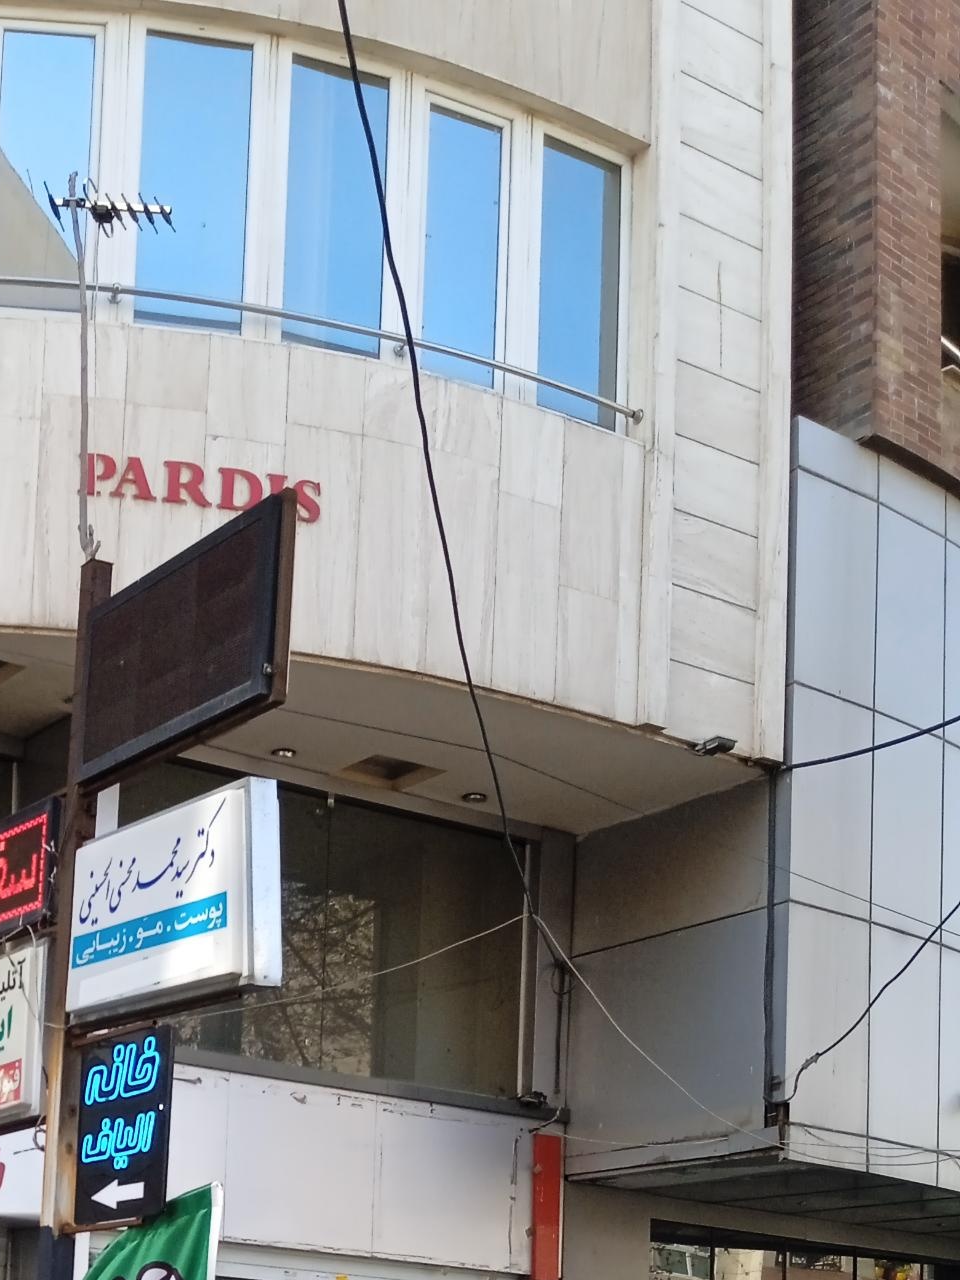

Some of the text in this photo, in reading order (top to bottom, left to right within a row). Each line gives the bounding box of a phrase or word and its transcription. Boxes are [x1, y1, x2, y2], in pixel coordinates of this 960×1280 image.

[79, 453, 321, 523] PARDIS
[174, 901, 223, 929] پوست
[75, 929, 127, 965] زیبایی
